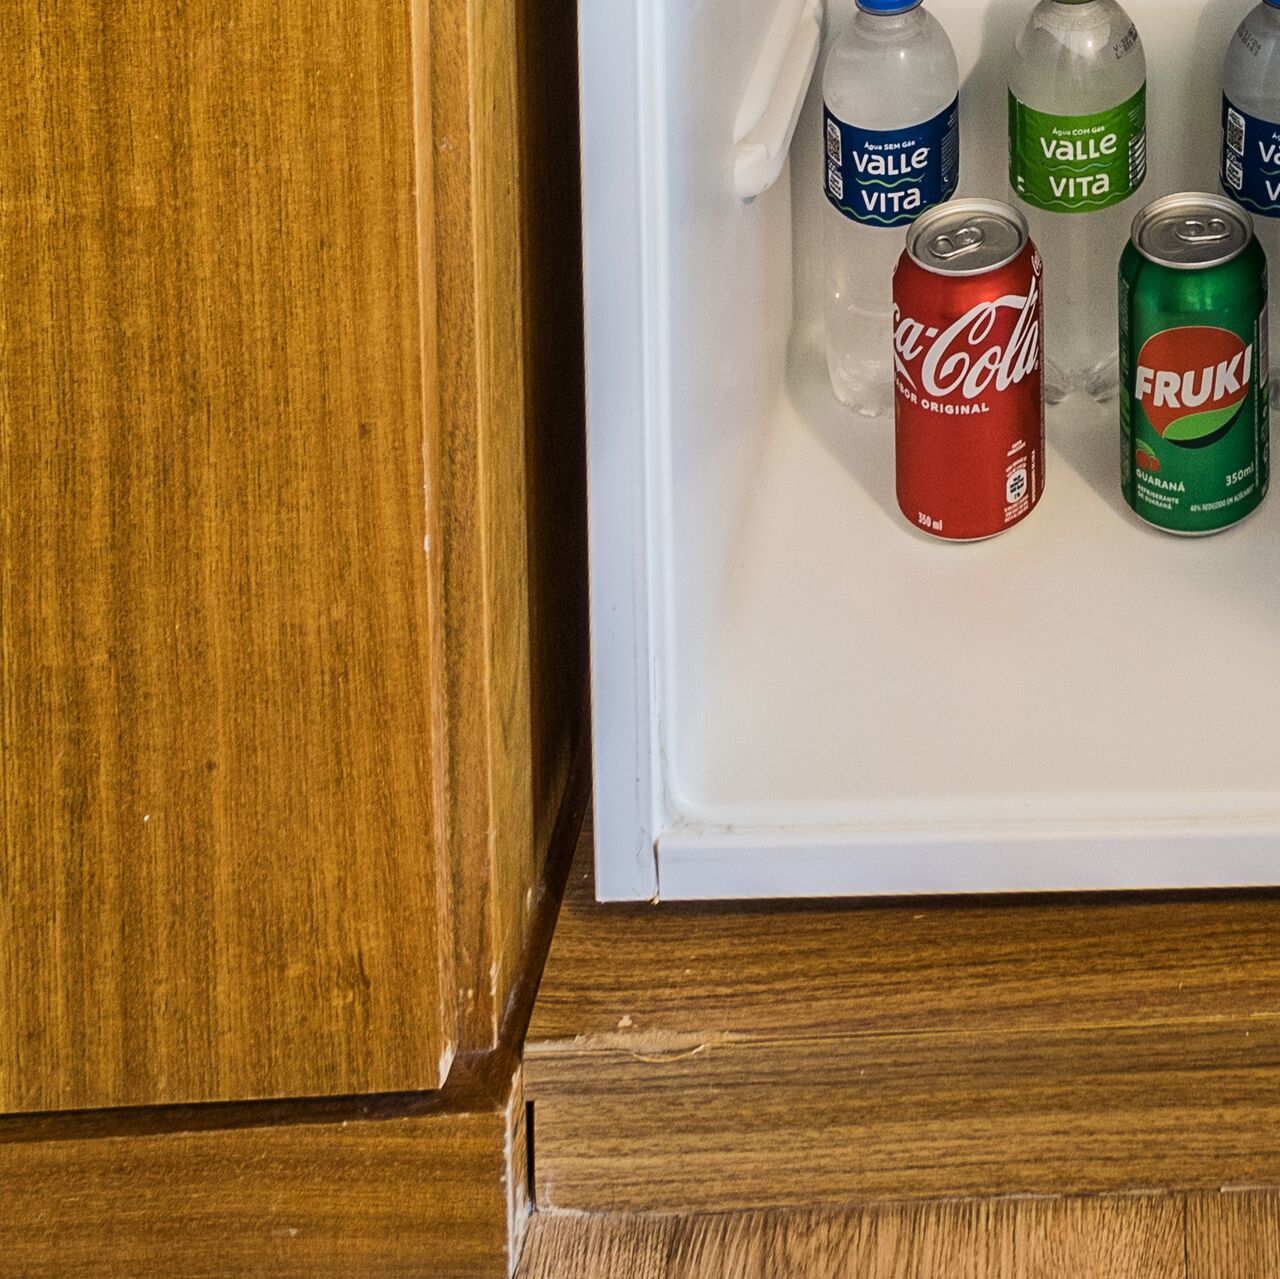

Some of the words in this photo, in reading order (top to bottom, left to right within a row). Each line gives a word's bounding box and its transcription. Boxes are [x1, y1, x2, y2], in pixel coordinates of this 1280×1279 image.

[1072, 128, 1090, 137] COM
[883, 143, 901, 151] SEM
[1135, 343, 1253, 409] FRUKI
[896, 377, 919, 406] BOR
[920, 398, 990, 415] ORIGINAL
[1136, 468, 1186, 493] GUARANÁ
[1225, 461, 1255, 487] 350ml
[1137, 483, 1180, 505] REFRIGERANTE
[917, 511, 932, 528] 350
